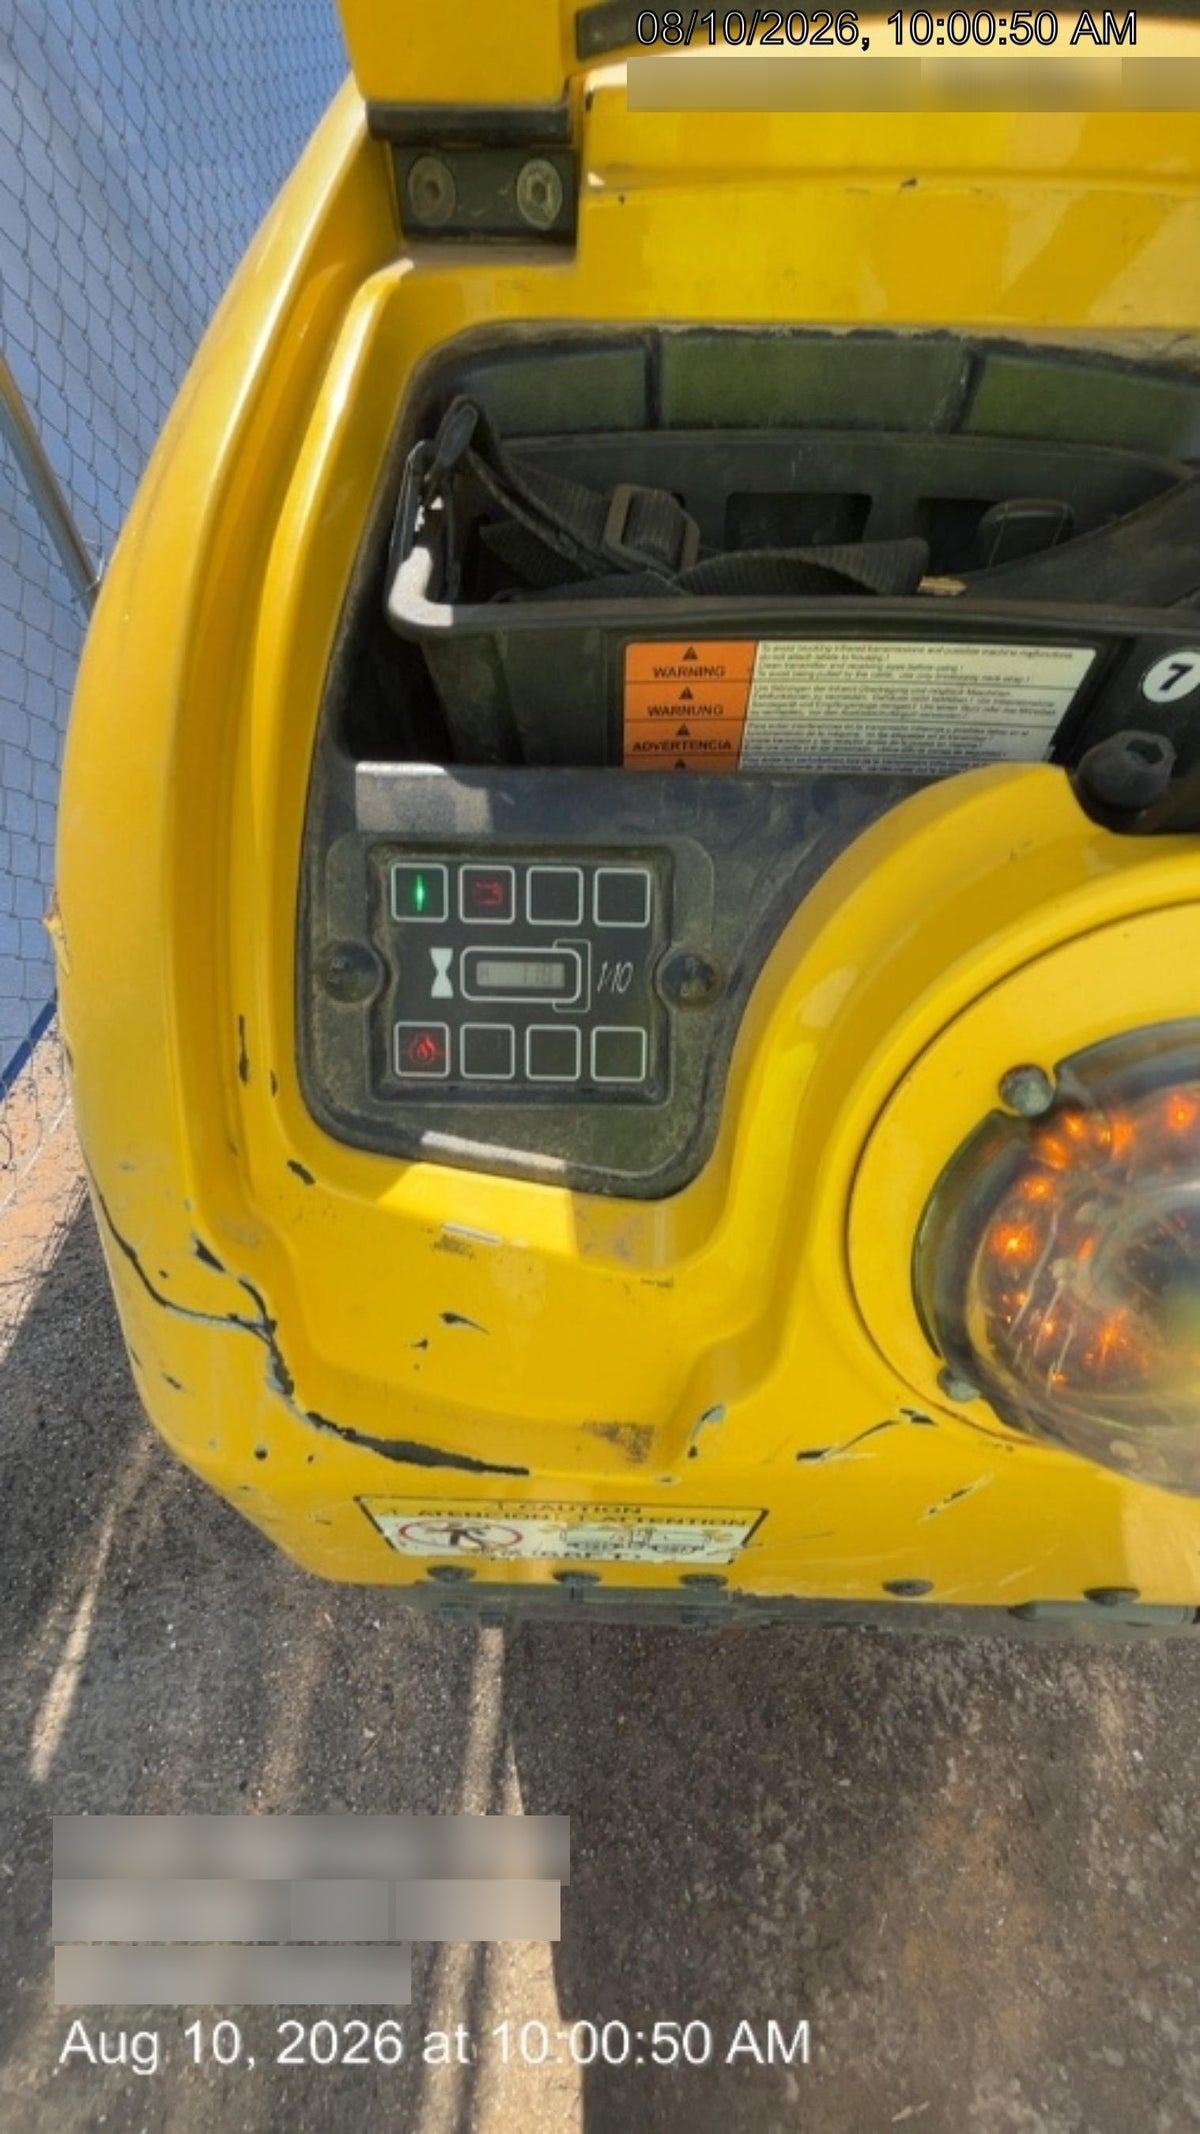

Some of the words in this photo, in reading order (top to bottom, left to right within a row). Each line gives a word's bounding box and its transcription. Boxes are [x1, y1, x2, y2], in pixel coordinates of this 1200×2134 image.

[652, 665, 727, 678] WARNING
[1158, 663, 1194, 691] 7
[632, 740, 732, 752] ADVERTENCIA
